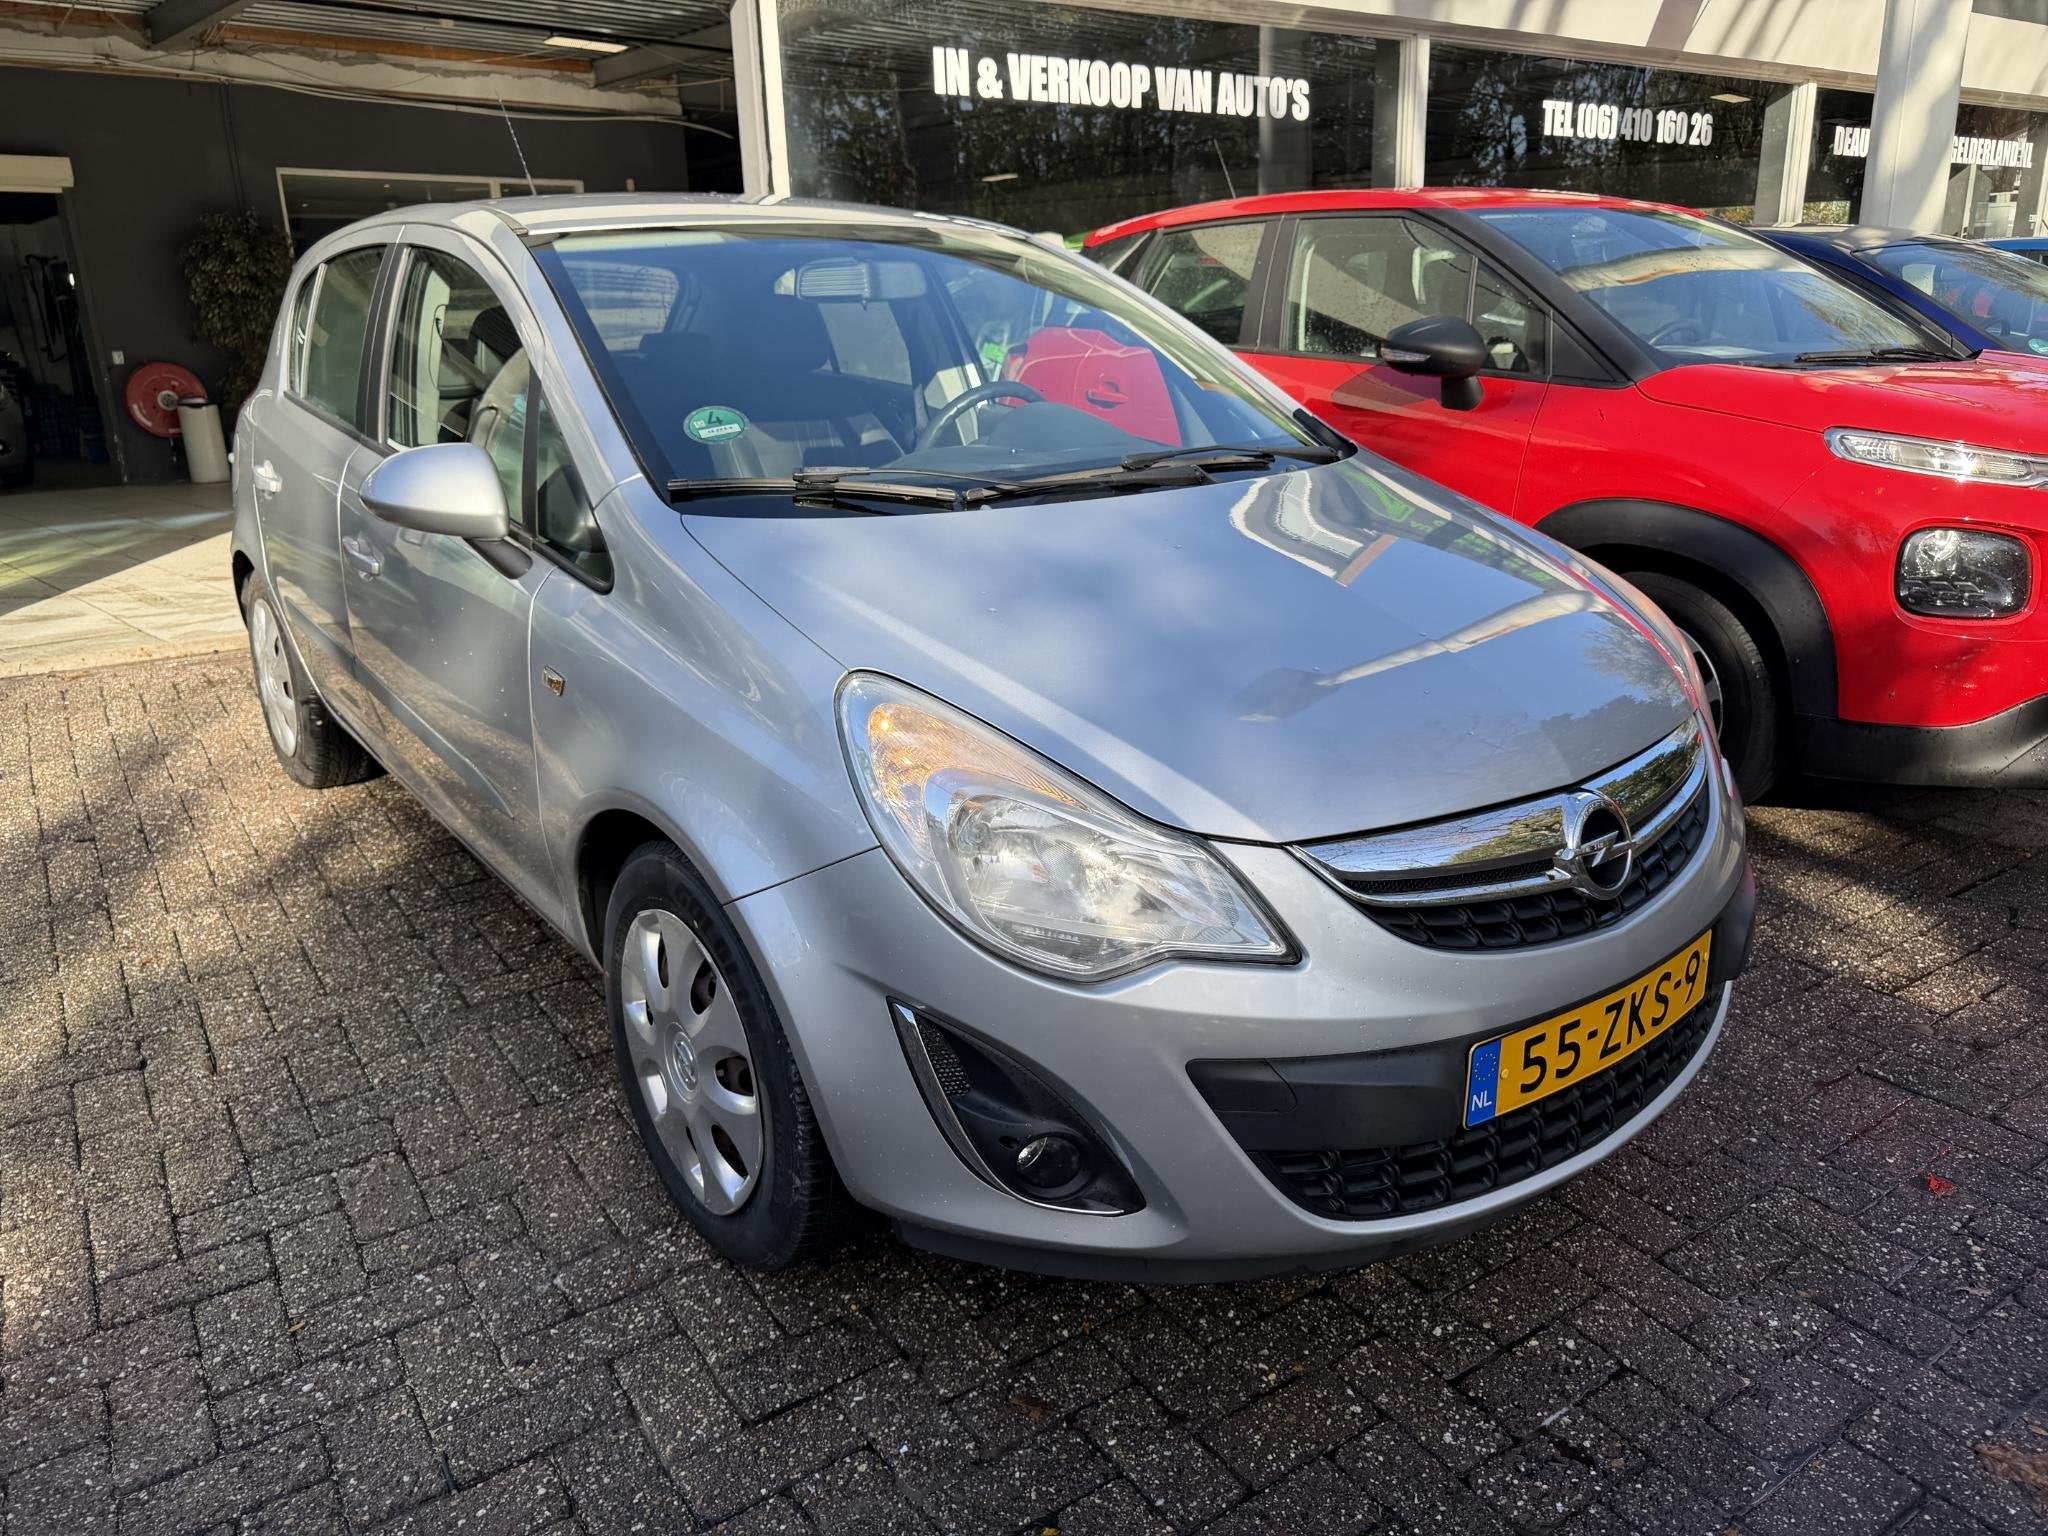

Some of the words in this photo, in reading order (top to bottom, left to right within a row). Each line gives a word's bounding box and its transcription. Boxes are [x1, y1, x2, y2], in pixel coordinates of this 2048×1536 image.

[932, 46, 970, 97] IN
[977, 57, 1003, 99] &
[1007, 52, 1150, 109] VERKOOP
[1154, 66, 1213, 114] VAN
[1216, 72, 1310, 121] AUTO'S
[1543, 100, 1574, 137] TEL
[1577, 103, 1619, 140] (06)
[1620, 107, 1653, 142] 410
[1656, 109, 1688, 145] 160
[1689, 112, 1713, 146] 26
[708, 411, 722, 424] 4
[1520, 950, 1700, 1094] 55-ZKS-9
[1471, 1091, 1492, 1111] NL
